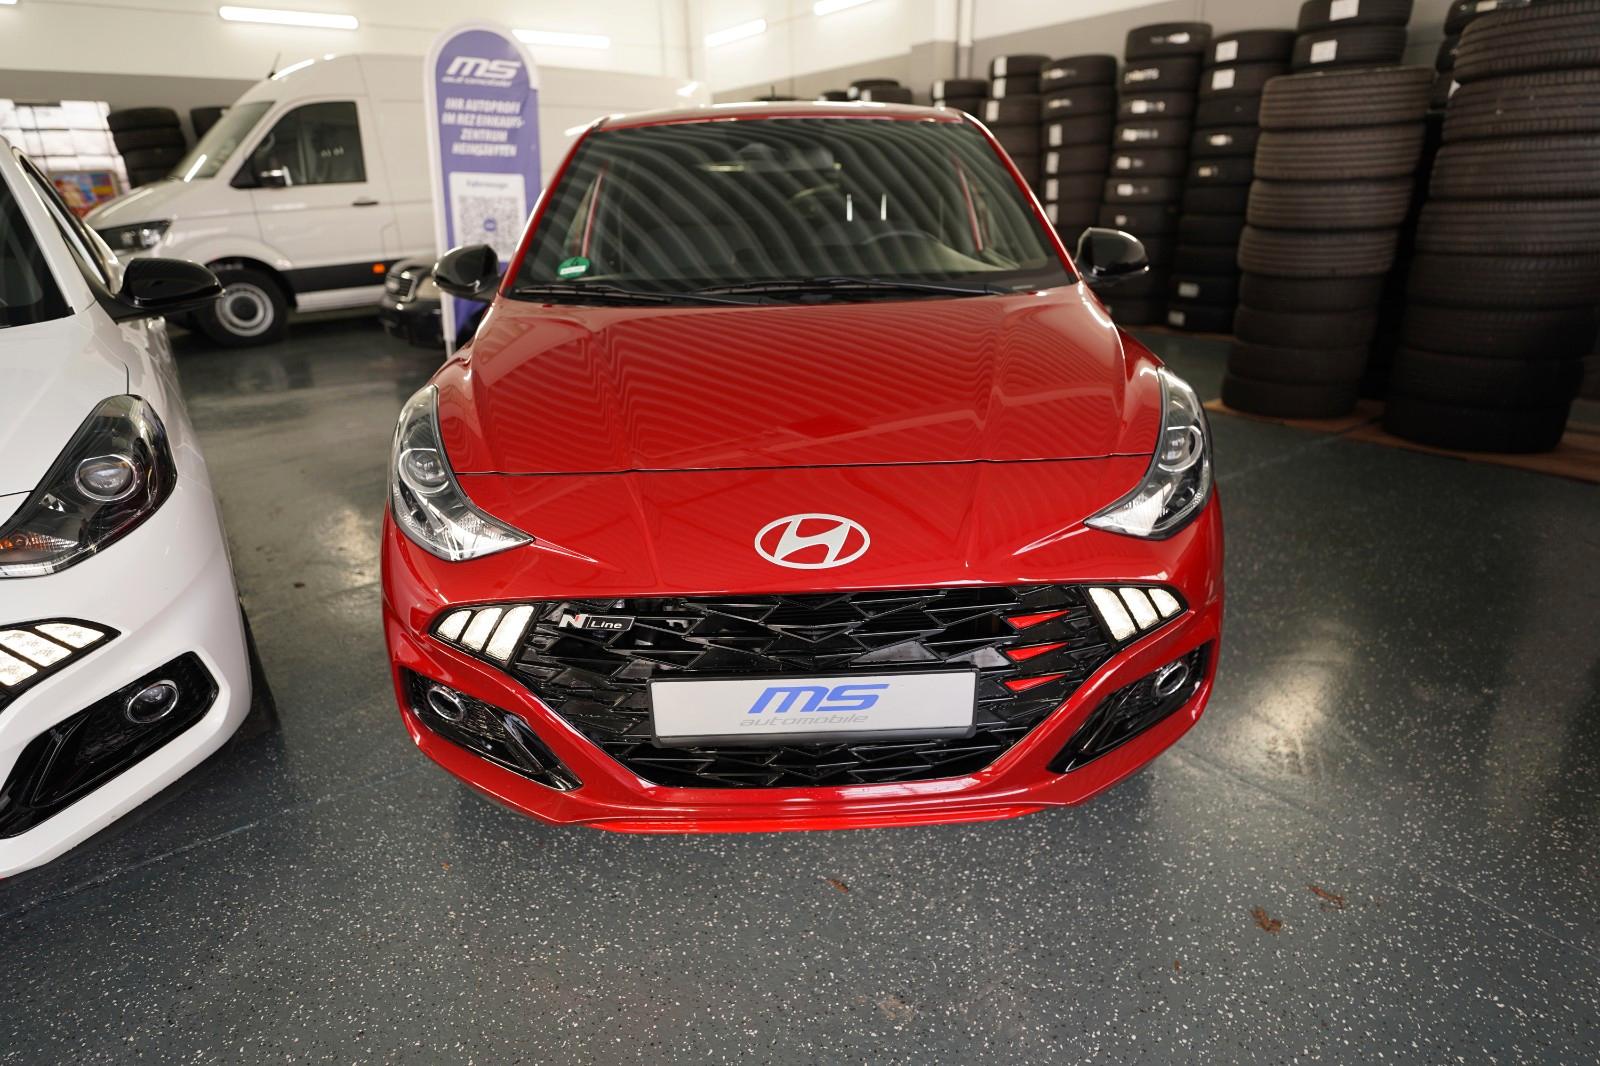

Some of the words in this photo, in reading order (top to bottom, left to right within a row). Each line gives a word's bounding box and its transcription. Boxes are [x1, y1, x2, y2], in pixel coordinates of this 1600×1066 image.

[461, 128, 508, 142] ZENTRUM
[559, 613, 588, 629] N
[590, 620, 623, 629] Line
[740, 713, 869, 727] automobile
